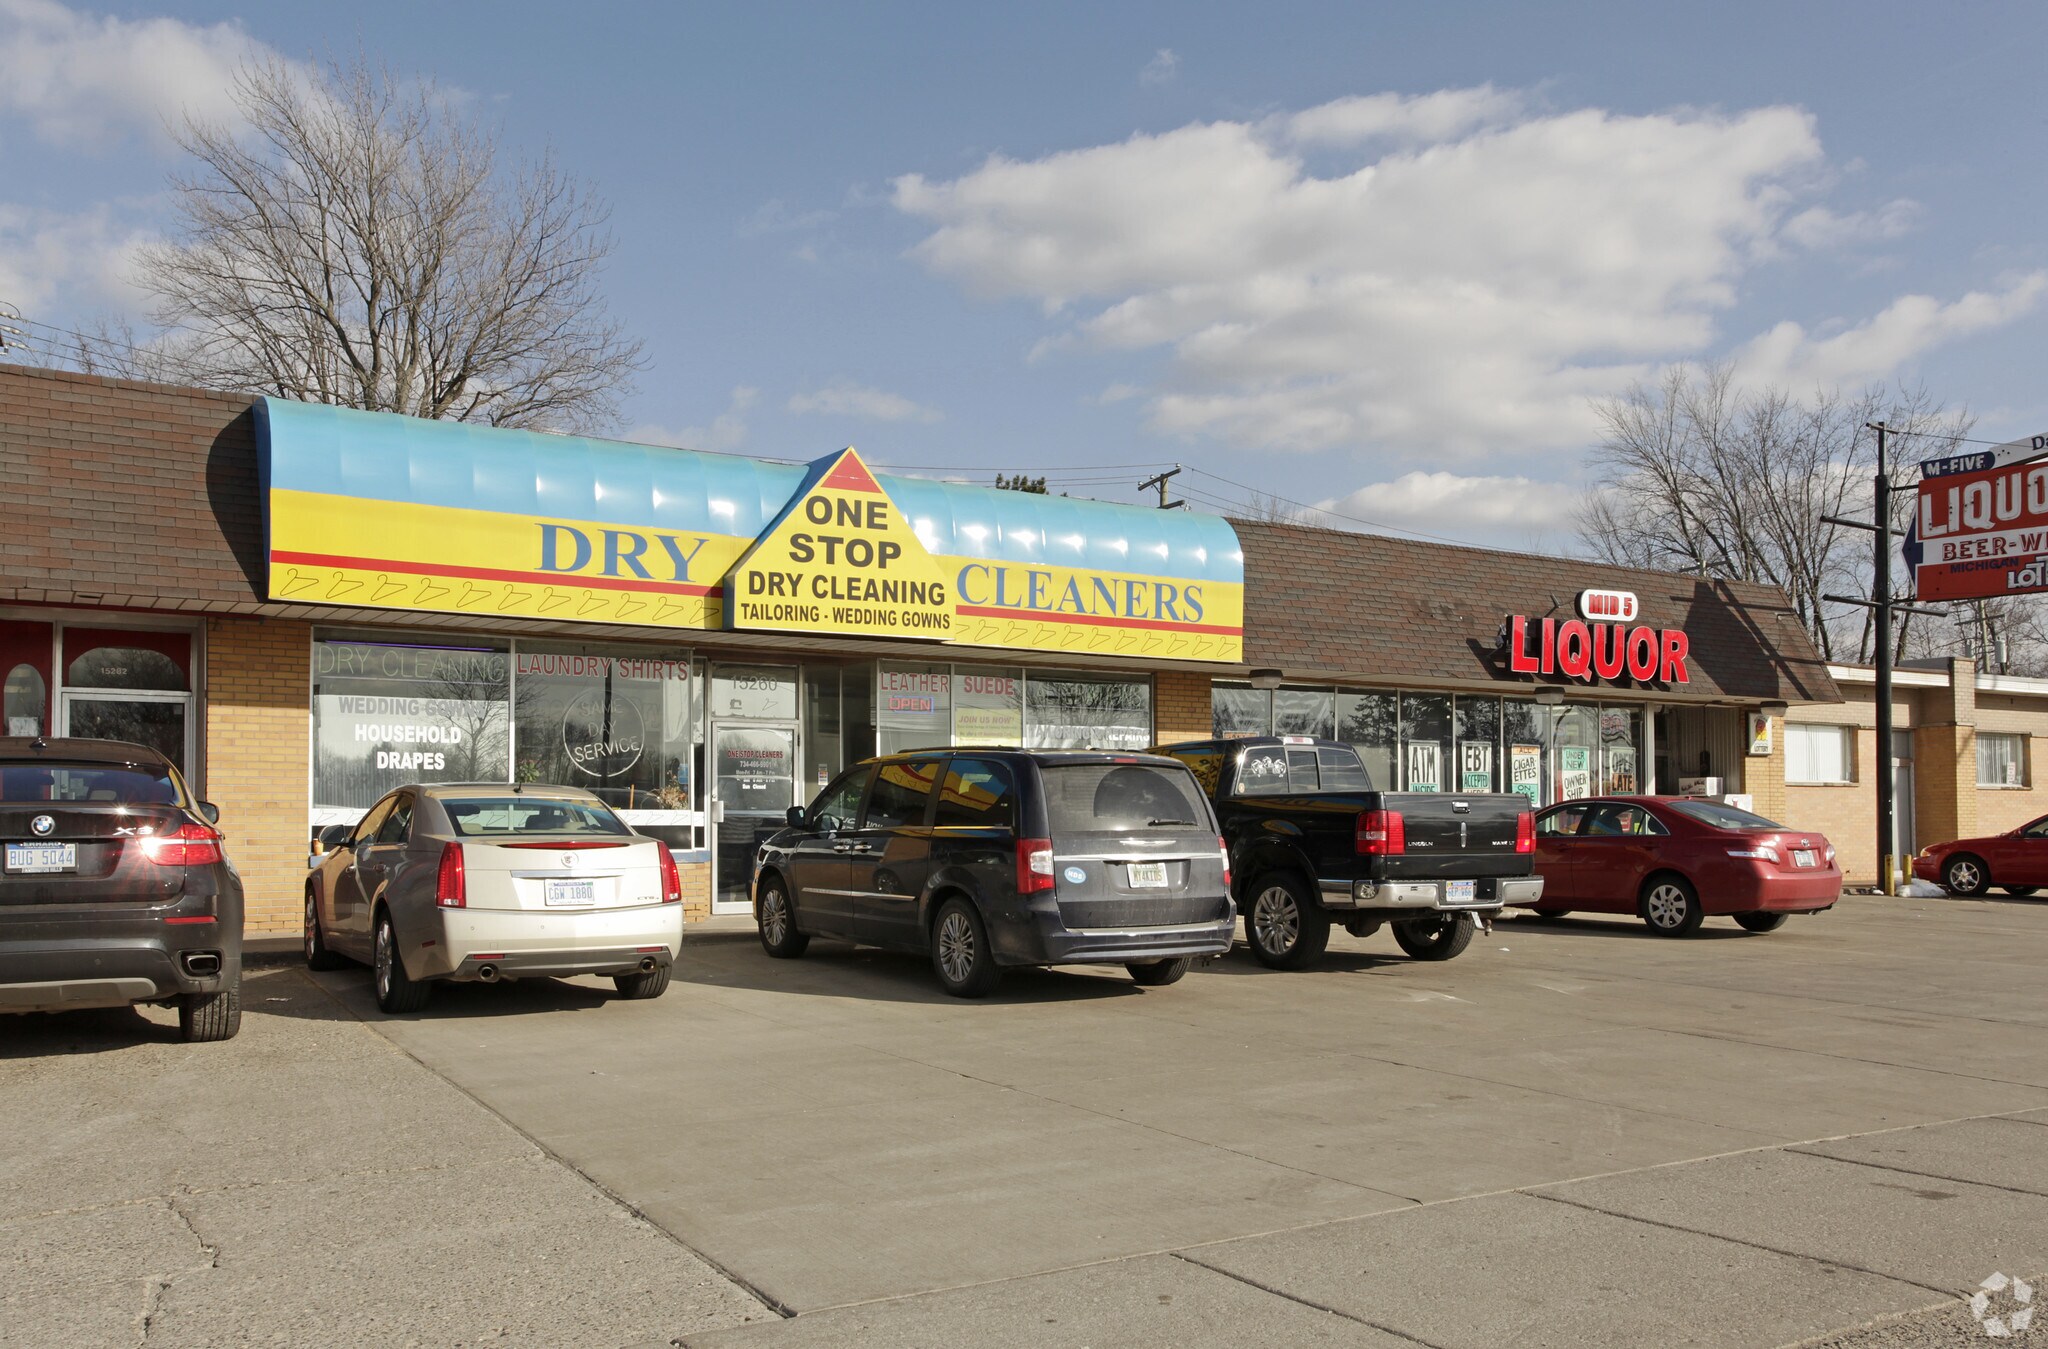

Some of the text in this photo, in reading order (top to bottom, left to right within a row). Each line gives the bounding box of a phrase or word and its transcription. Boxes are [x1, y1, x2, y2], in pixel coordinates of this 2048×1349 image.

[1925, 454, 1986, 476] M-FIVE
[805, 495, 889, 531] ONE
[534, 523, 709, 583] DRY
[788, 533, 902, 569] STOP
[1950, 557, 2019, 574] MICHIGAN
[748, 571, 946, 606] DRY CLEANING
[957, 563, 1204, 623] CLEANERS
[741, 602, 820, 623] TAILORING
[832, 606, 897, 627] WEDDING
[901, 610, 950, 629] GOWNS
[1588, 594, 1633, 617] MID 5
[1511, 615, 1690, 684] LIQUOR
[318, 645, 505, 682] DRY CLEANING
[517, 654, 689, 682] LAUNDRY SHIRTS
[731, 675, 778, 691] 15260
[881, 673, 1015, 696] LEATHER SUEDE
[338, 696, 489, 719] WEDDING GOWNS
[581, 698, 624, 717] SAME
[889, 697, 931, 711] OPEN
[588, 719, 617, 738] DAY
[958, 715, 978, 724] JOIN
[980, 716, 990, 724] US
[355, 723, 462, 744] HOUSEHOLD
[574, 735, 641, 763] SERVICE
[727, 750, 784, 759] ONE STOP CLEANERS
[1466, 746, 1489, 772] EBT
[1566, 749, 1585, 760] UNDER
[376, 751, 446, 770] DRAPES
[1412, 746, 1437, 783] ATM
[1566, 761, 1585, 769] NEW
[1612, 752, 1634, 773] OPEN
[1514, 767, 1537, 782] ETTES
[1612, 774, 1633, 792] LATE
[1567, 786, 1584, 800] SHIP
[42, 850, 73, 865] 5044
